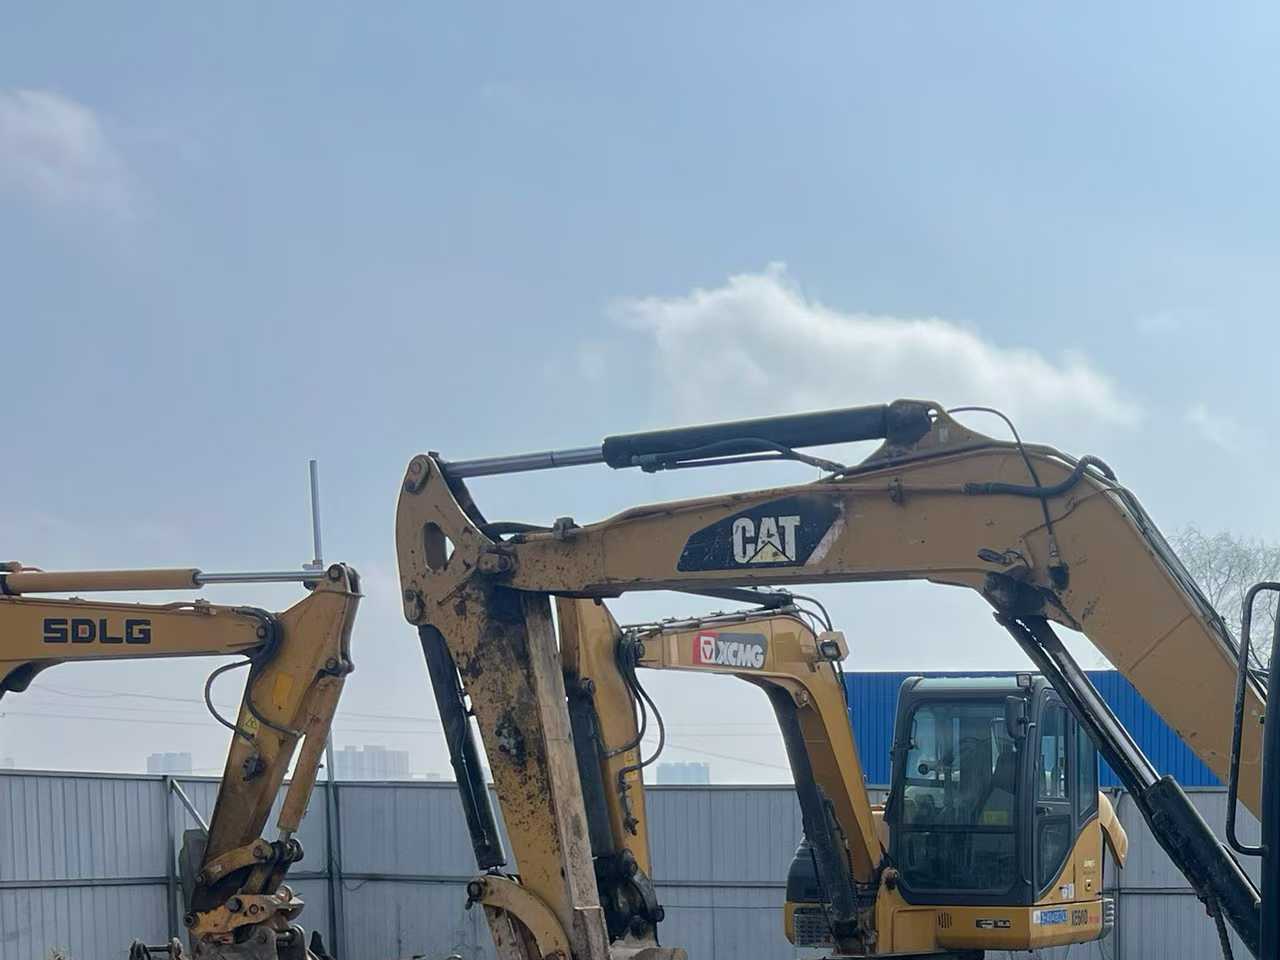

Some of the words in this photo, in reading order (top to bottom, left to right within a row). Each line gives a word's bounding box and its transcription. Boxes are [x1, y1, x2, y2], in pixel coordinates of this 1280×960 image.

[732, 515, 800, 563] CAT
[43, 618, 152, 644] SDLG
[716, 640, 764, 668] XCMG
